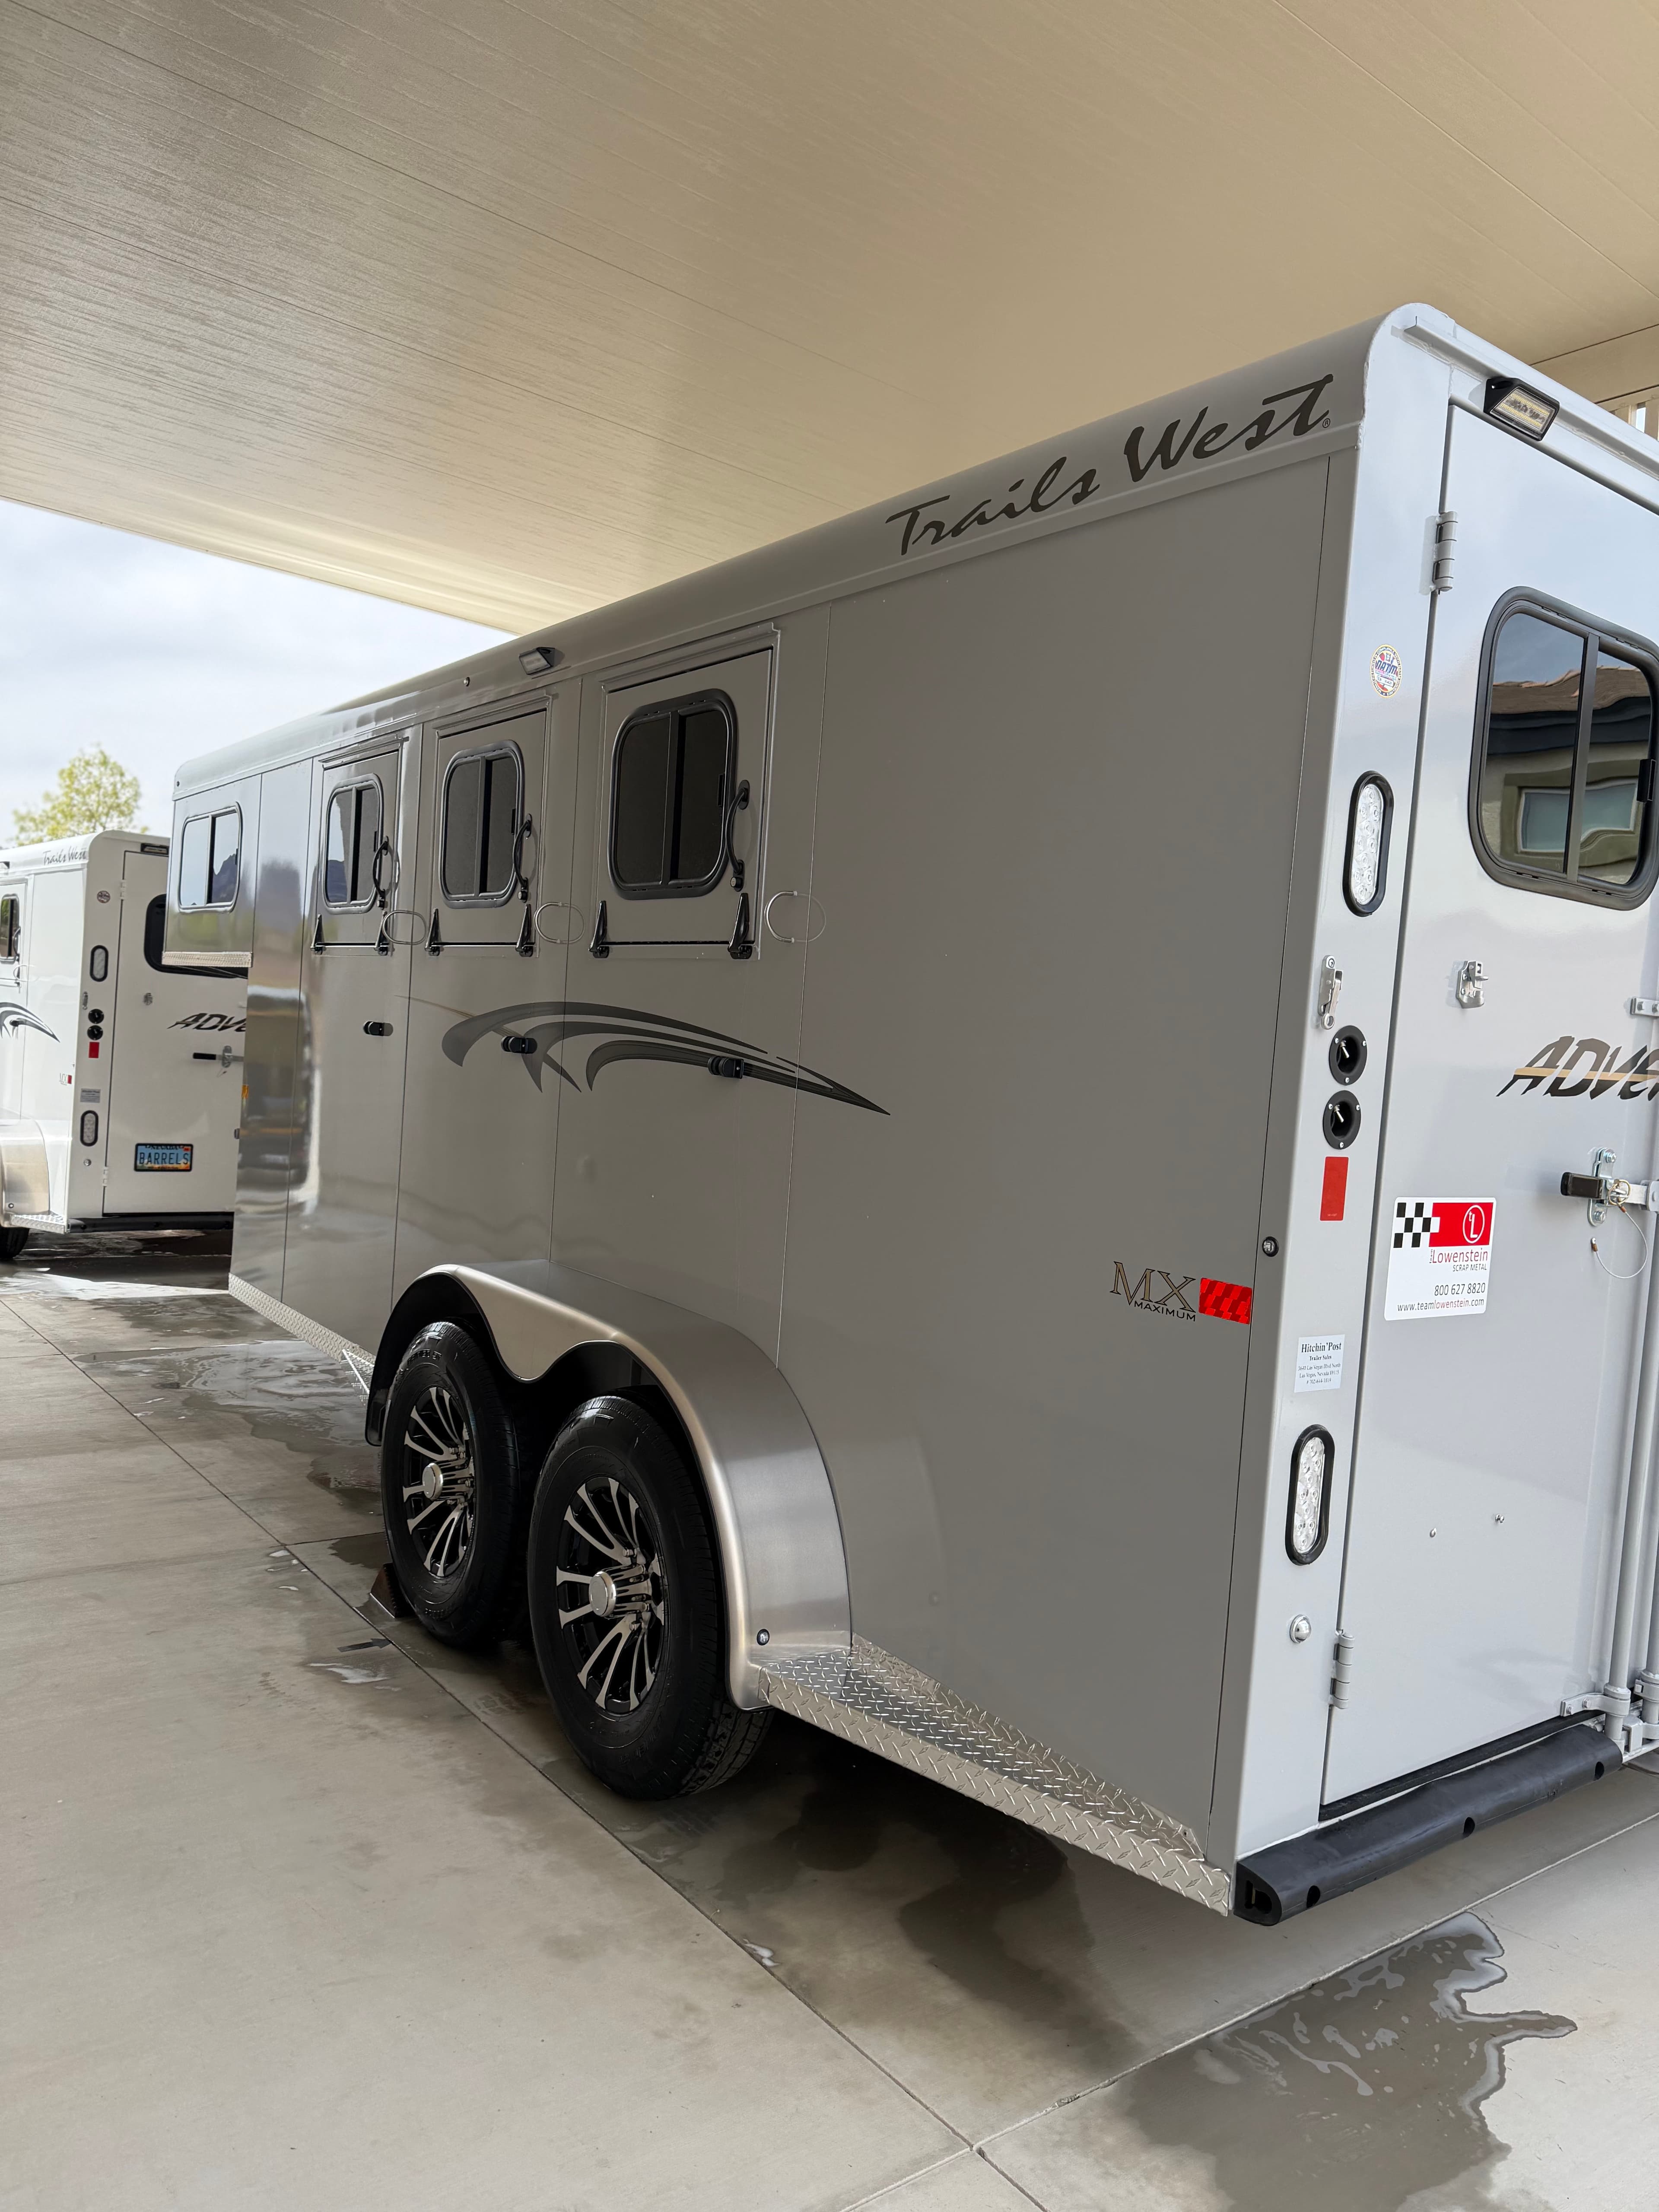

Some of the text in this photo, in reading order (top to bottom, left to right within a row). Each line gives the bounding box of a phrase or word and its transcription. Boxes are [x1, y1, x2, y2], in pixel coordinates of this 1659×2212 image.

[885, 374, 1334, 556] Trails West
[43, 849, 66, 865] Trails
[139, 1152, 189, 1165] BARRELS
[1433, 1248, 1488, 1263] Lowenstein
[1109, 1261, 1196, 1313] MX
[1434, 1283, 1485, 1296] 800 627 8820
[1134, 1300, 1196, 1322] MAXIMUM
[1397, 1298, 1484, 1312] www.teamlowenstein.com
[1301, 1342, 1341, 1353] Hitchin' Post
